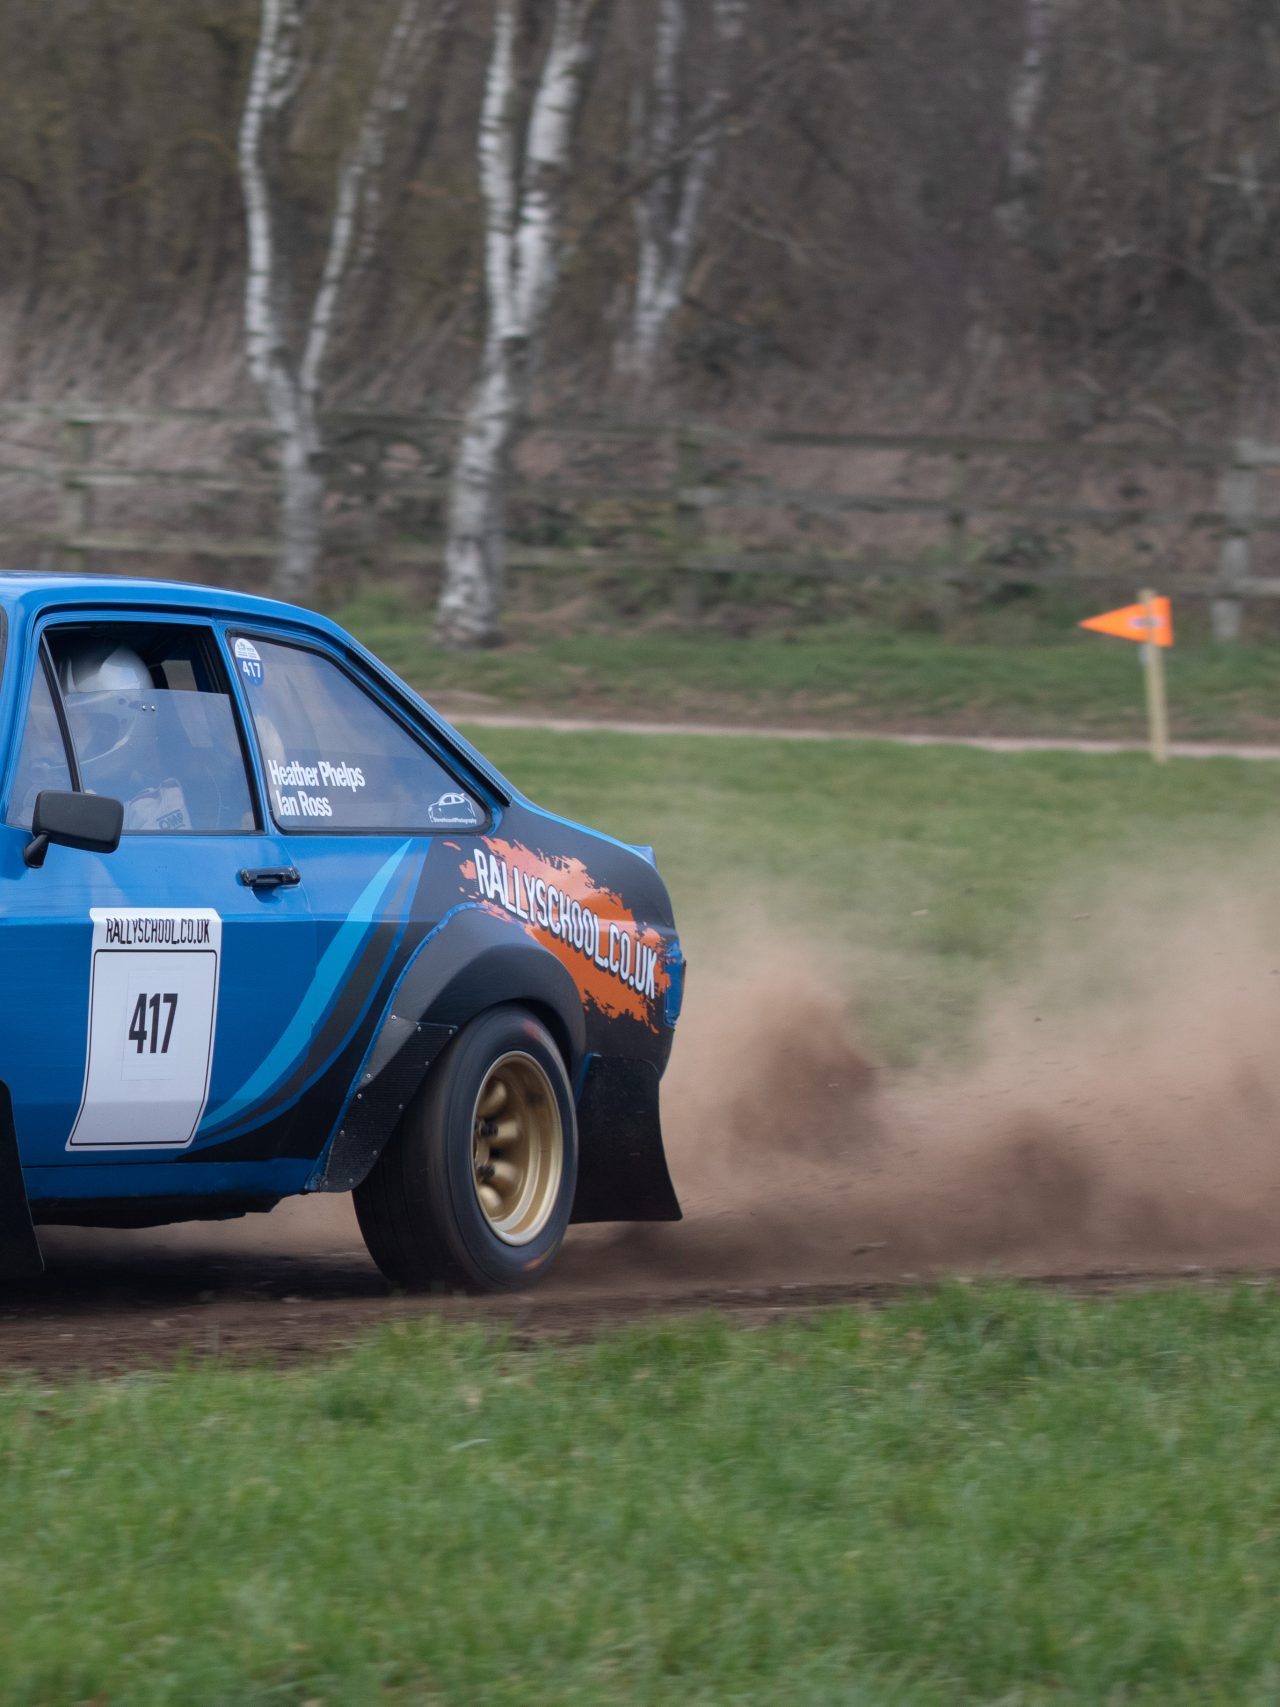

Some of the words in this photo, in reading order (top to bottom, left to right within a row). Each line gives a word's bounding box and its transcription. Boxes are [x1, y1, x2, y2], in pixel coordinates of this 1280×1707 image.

[242, 660, 261, 678] 417
[267, 759, 321, 787] Heather
[317, 760, 366, 793] Phelps
[275, 790, 301, 816] Ian
[297, 790, 333, 817] Ross
[105, 917, 211, 945] RALLYSCHOOL.CO.UK
[473, 848, 659, 1000] RALLYSCHOOL.CO.UK
[128, 992, 179, 1054] 417
